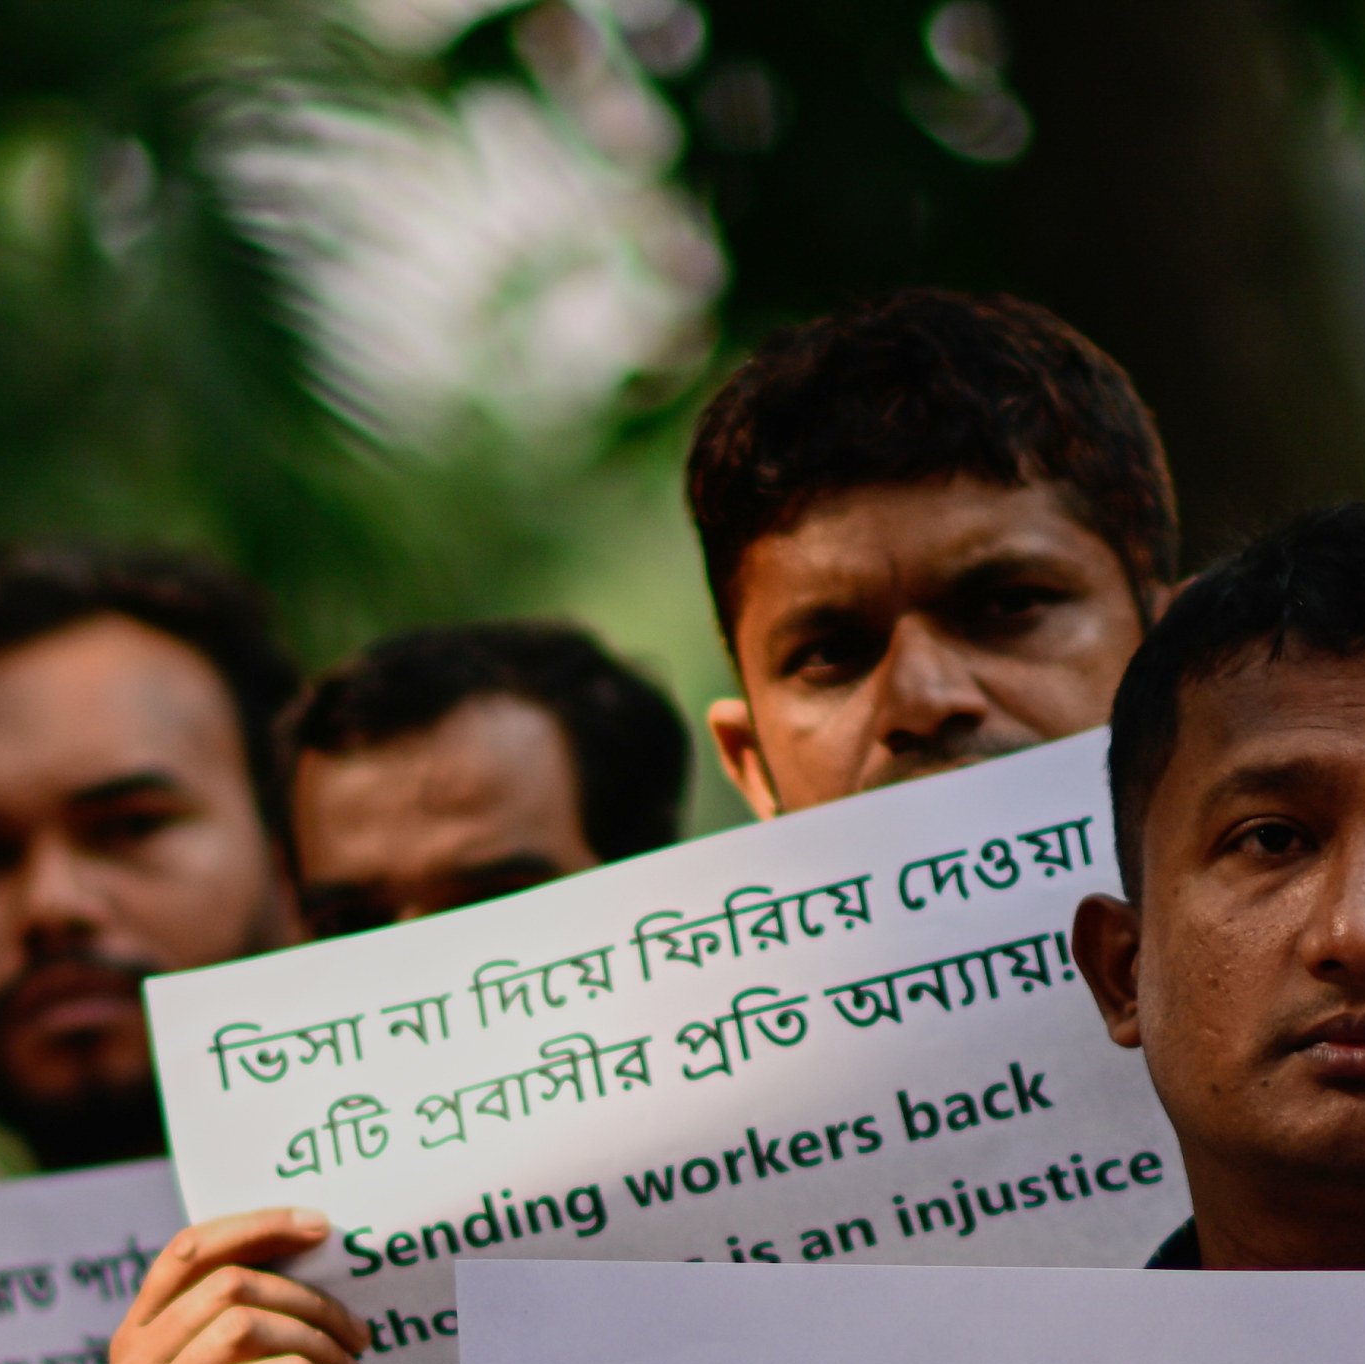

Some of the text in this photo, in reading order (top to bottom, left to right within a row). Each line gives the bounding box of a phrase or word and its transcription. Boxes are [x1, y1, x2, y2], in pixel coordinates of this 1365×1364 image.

[208, 817, 1093, 1091] ভিসা না দিয়ে ফিরিয়ে দেওয়া
[276, 931, 1075, 1179] এটি প্রবাসীর প্রতি অন্যায়!
[344, 1061, 1053, 1278] Sending workers back
[800, 1218, 877, 1262] an
[892, 1149, 1163, 1236] injustice
